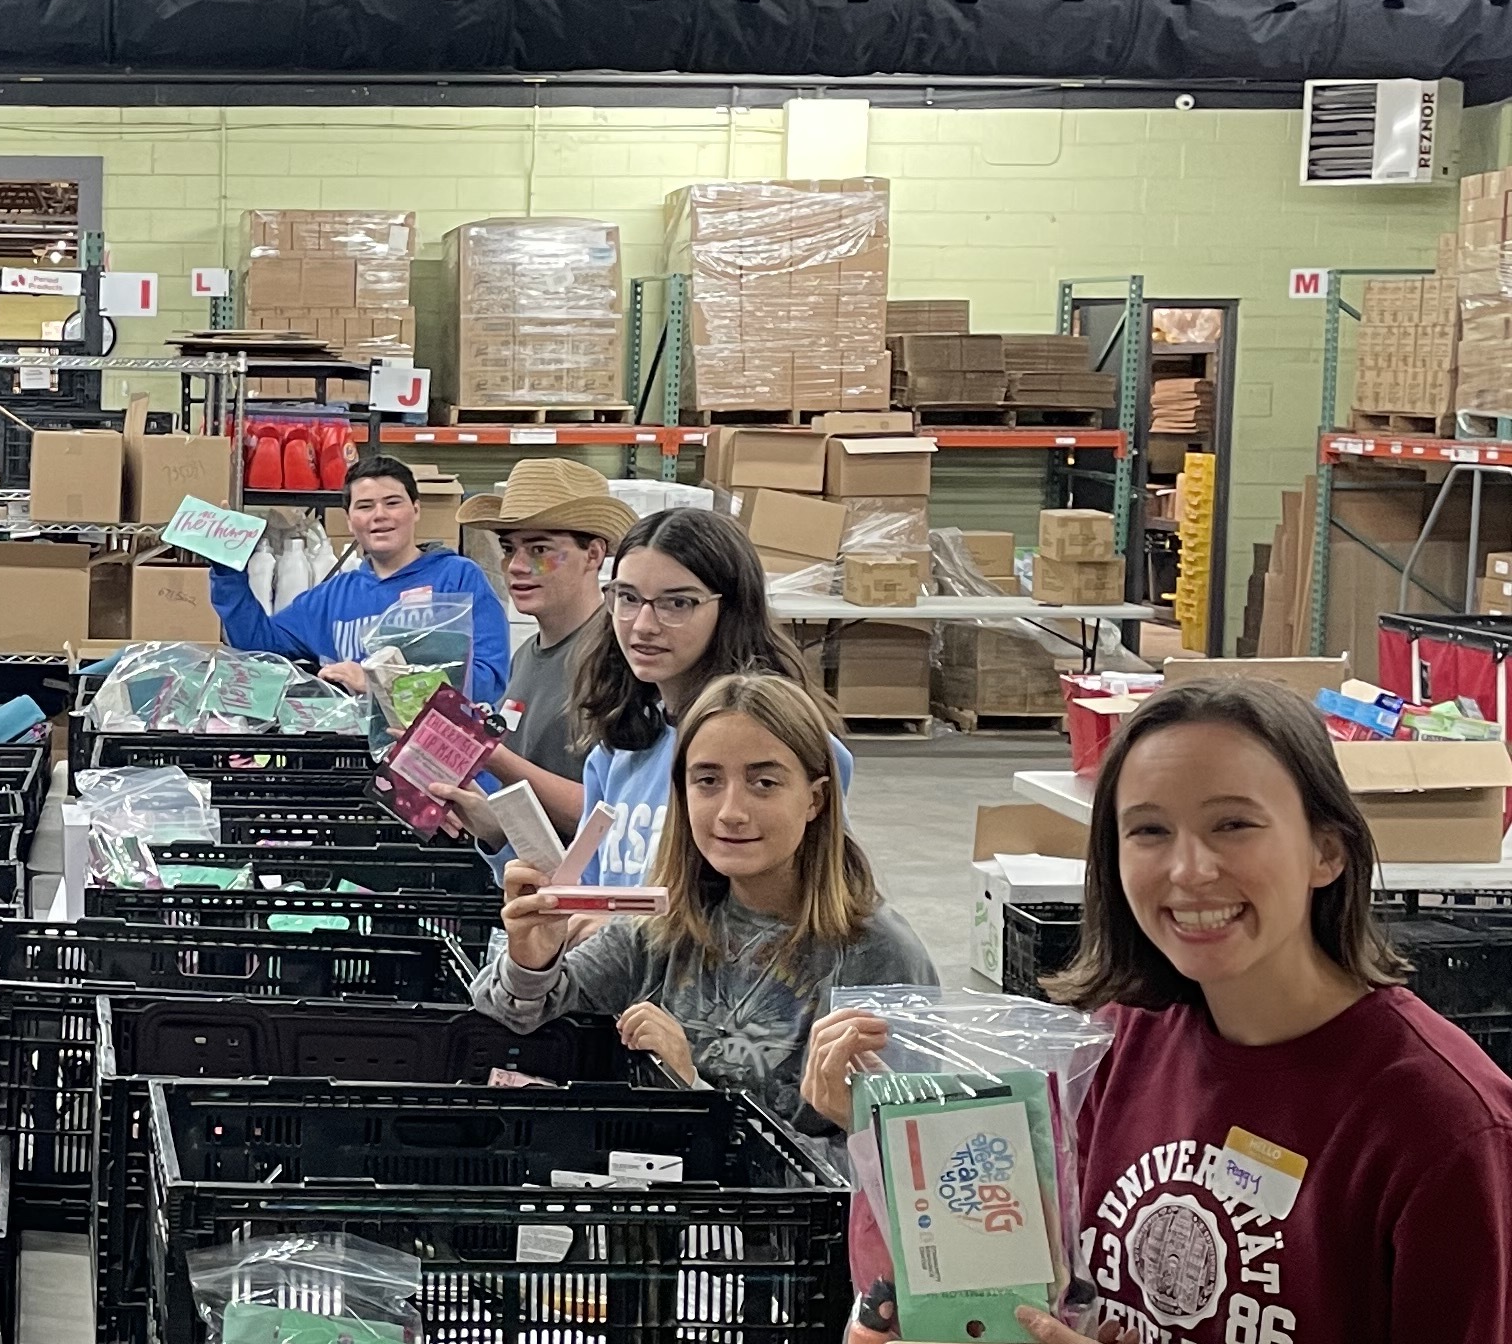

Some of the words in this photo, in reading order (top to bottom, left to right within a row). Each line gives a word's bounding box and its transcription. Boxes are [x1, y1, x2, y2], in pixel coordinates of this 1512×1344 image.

[1419, 92, 1435, 169] REZNOR
[140, 279, 150, 309] I
[196, 273, 211, 291] L
[1294, 274, 1320, 294] M
[397, 378, 422, 407] J
[174, 510, 207, 531] The
[205, 514, 260, 550] Things
[415, 728, 436, 750] LIP
[438, 742, 470, 778] MASK
[951, 1142, 983, 1216] Thank
[1226, 1159, 1263, 1194] Peggy
